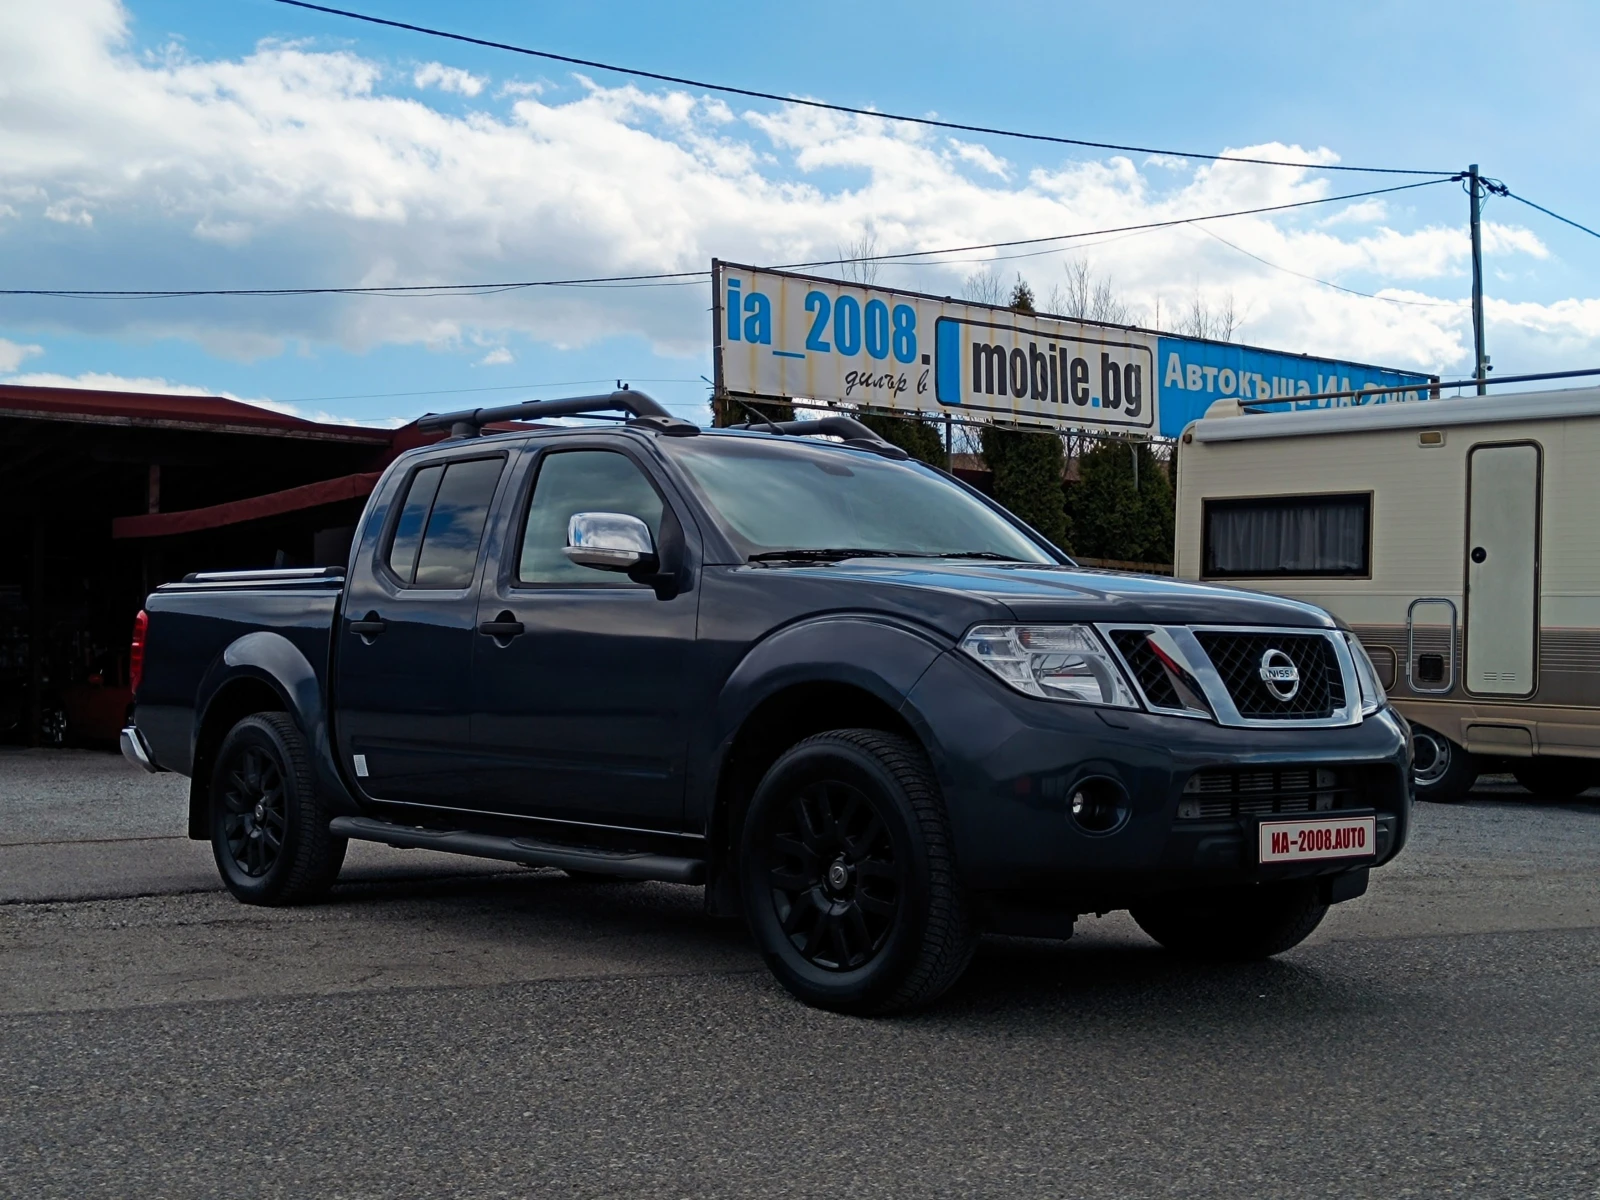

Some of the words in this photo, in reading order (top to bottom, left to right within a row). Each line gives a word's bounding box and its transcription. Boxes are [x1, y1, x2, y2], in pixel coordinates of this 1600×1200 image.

[845, 370, 908, 398] дилър
[972, 342, 1142, 417] mobile.bg
[1268, 668, 1298, 679] NISS
